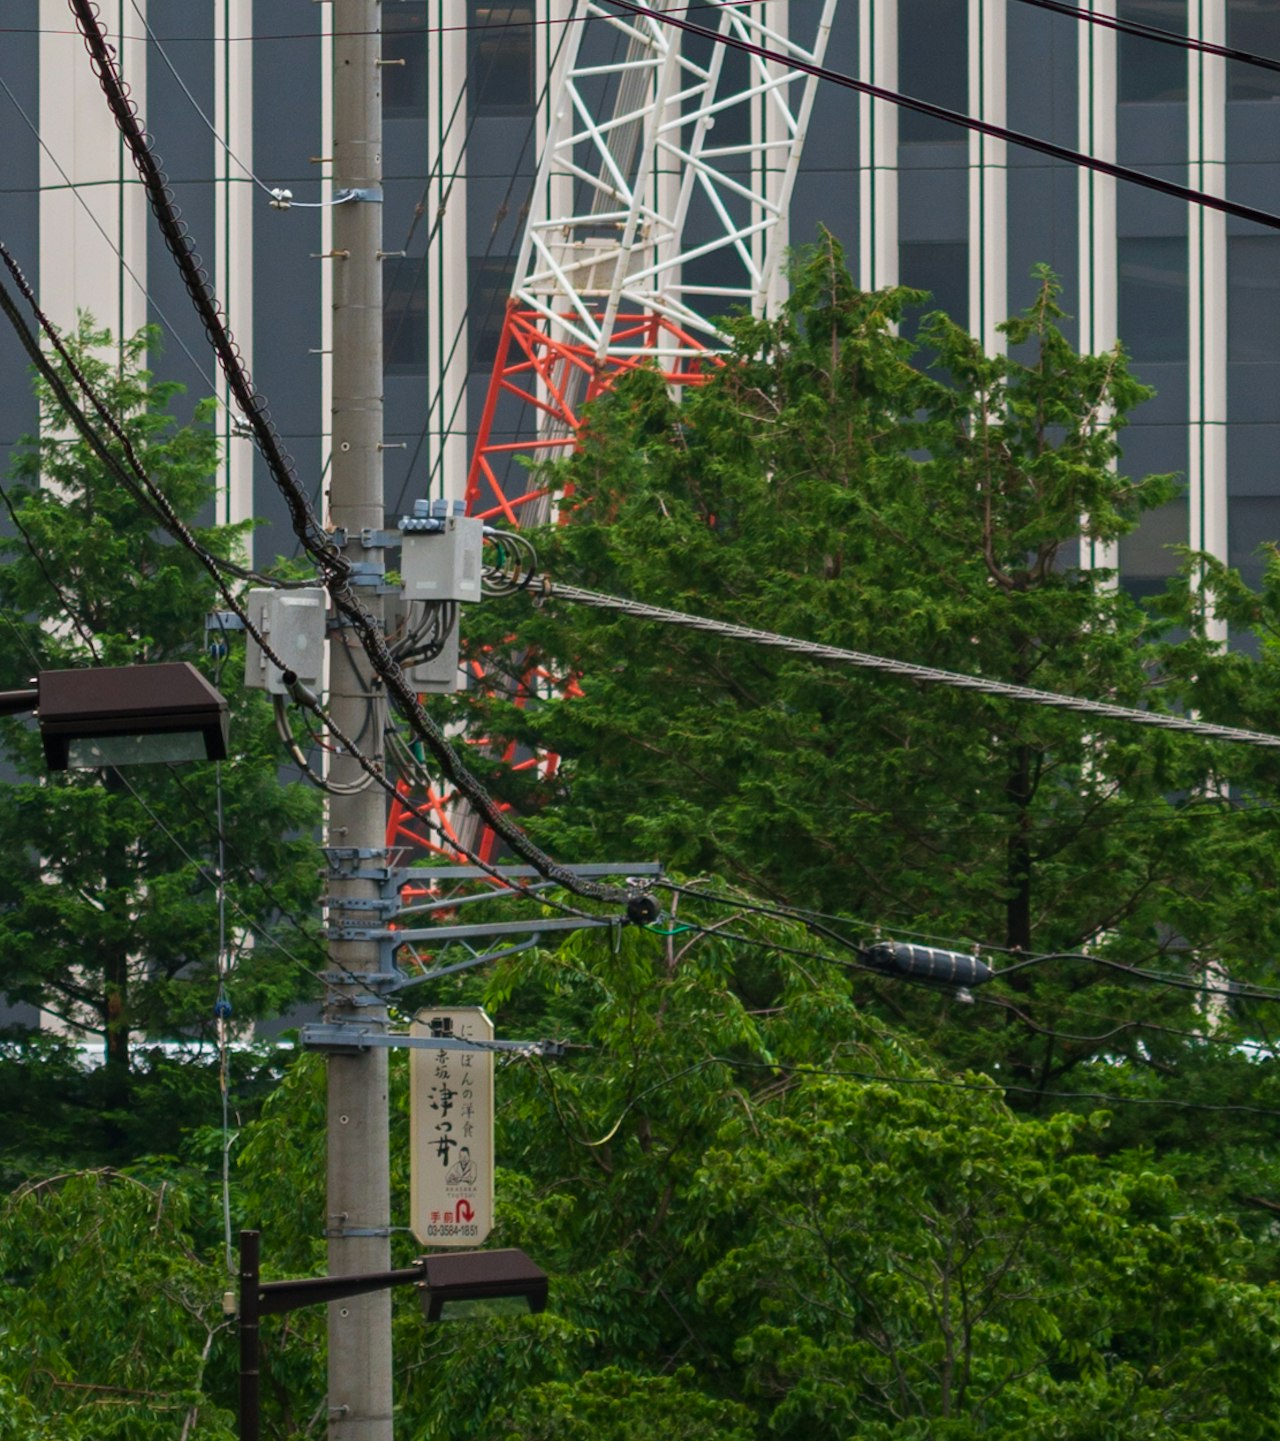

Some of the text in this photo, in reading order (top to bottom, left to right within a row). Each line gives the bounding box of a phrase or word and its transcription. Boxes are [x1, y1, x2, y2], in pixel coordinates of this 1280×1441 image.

[460, 1024, 475, 1138] にぽんの洋食
[427, 1224, 478, 1237] 03-3584-1851
